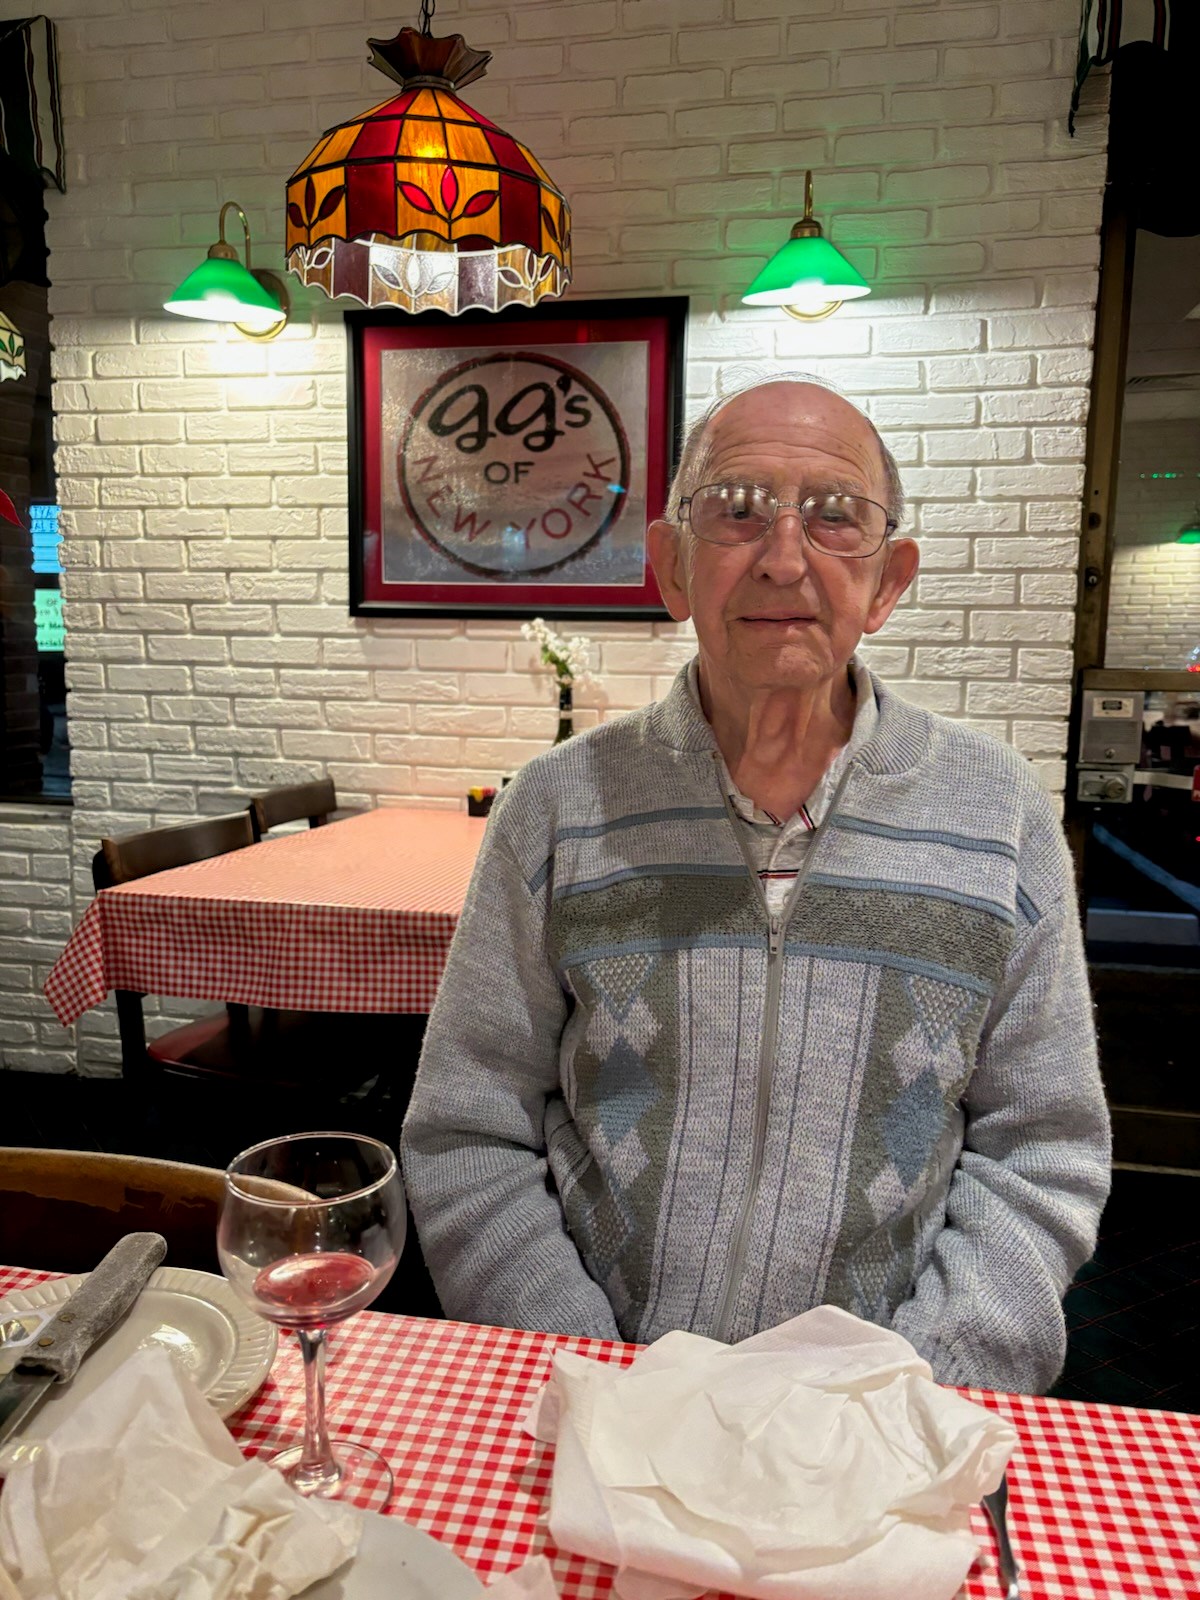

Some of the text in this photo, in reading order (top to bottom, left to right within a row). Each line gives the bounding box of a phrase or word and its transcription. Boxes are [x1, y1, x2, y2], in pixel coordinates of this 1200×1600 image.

[427, 374, 592, 454] gg's
[412, 453, 616, 549] NEW YORK
[484, 460, 535, 485] OF
